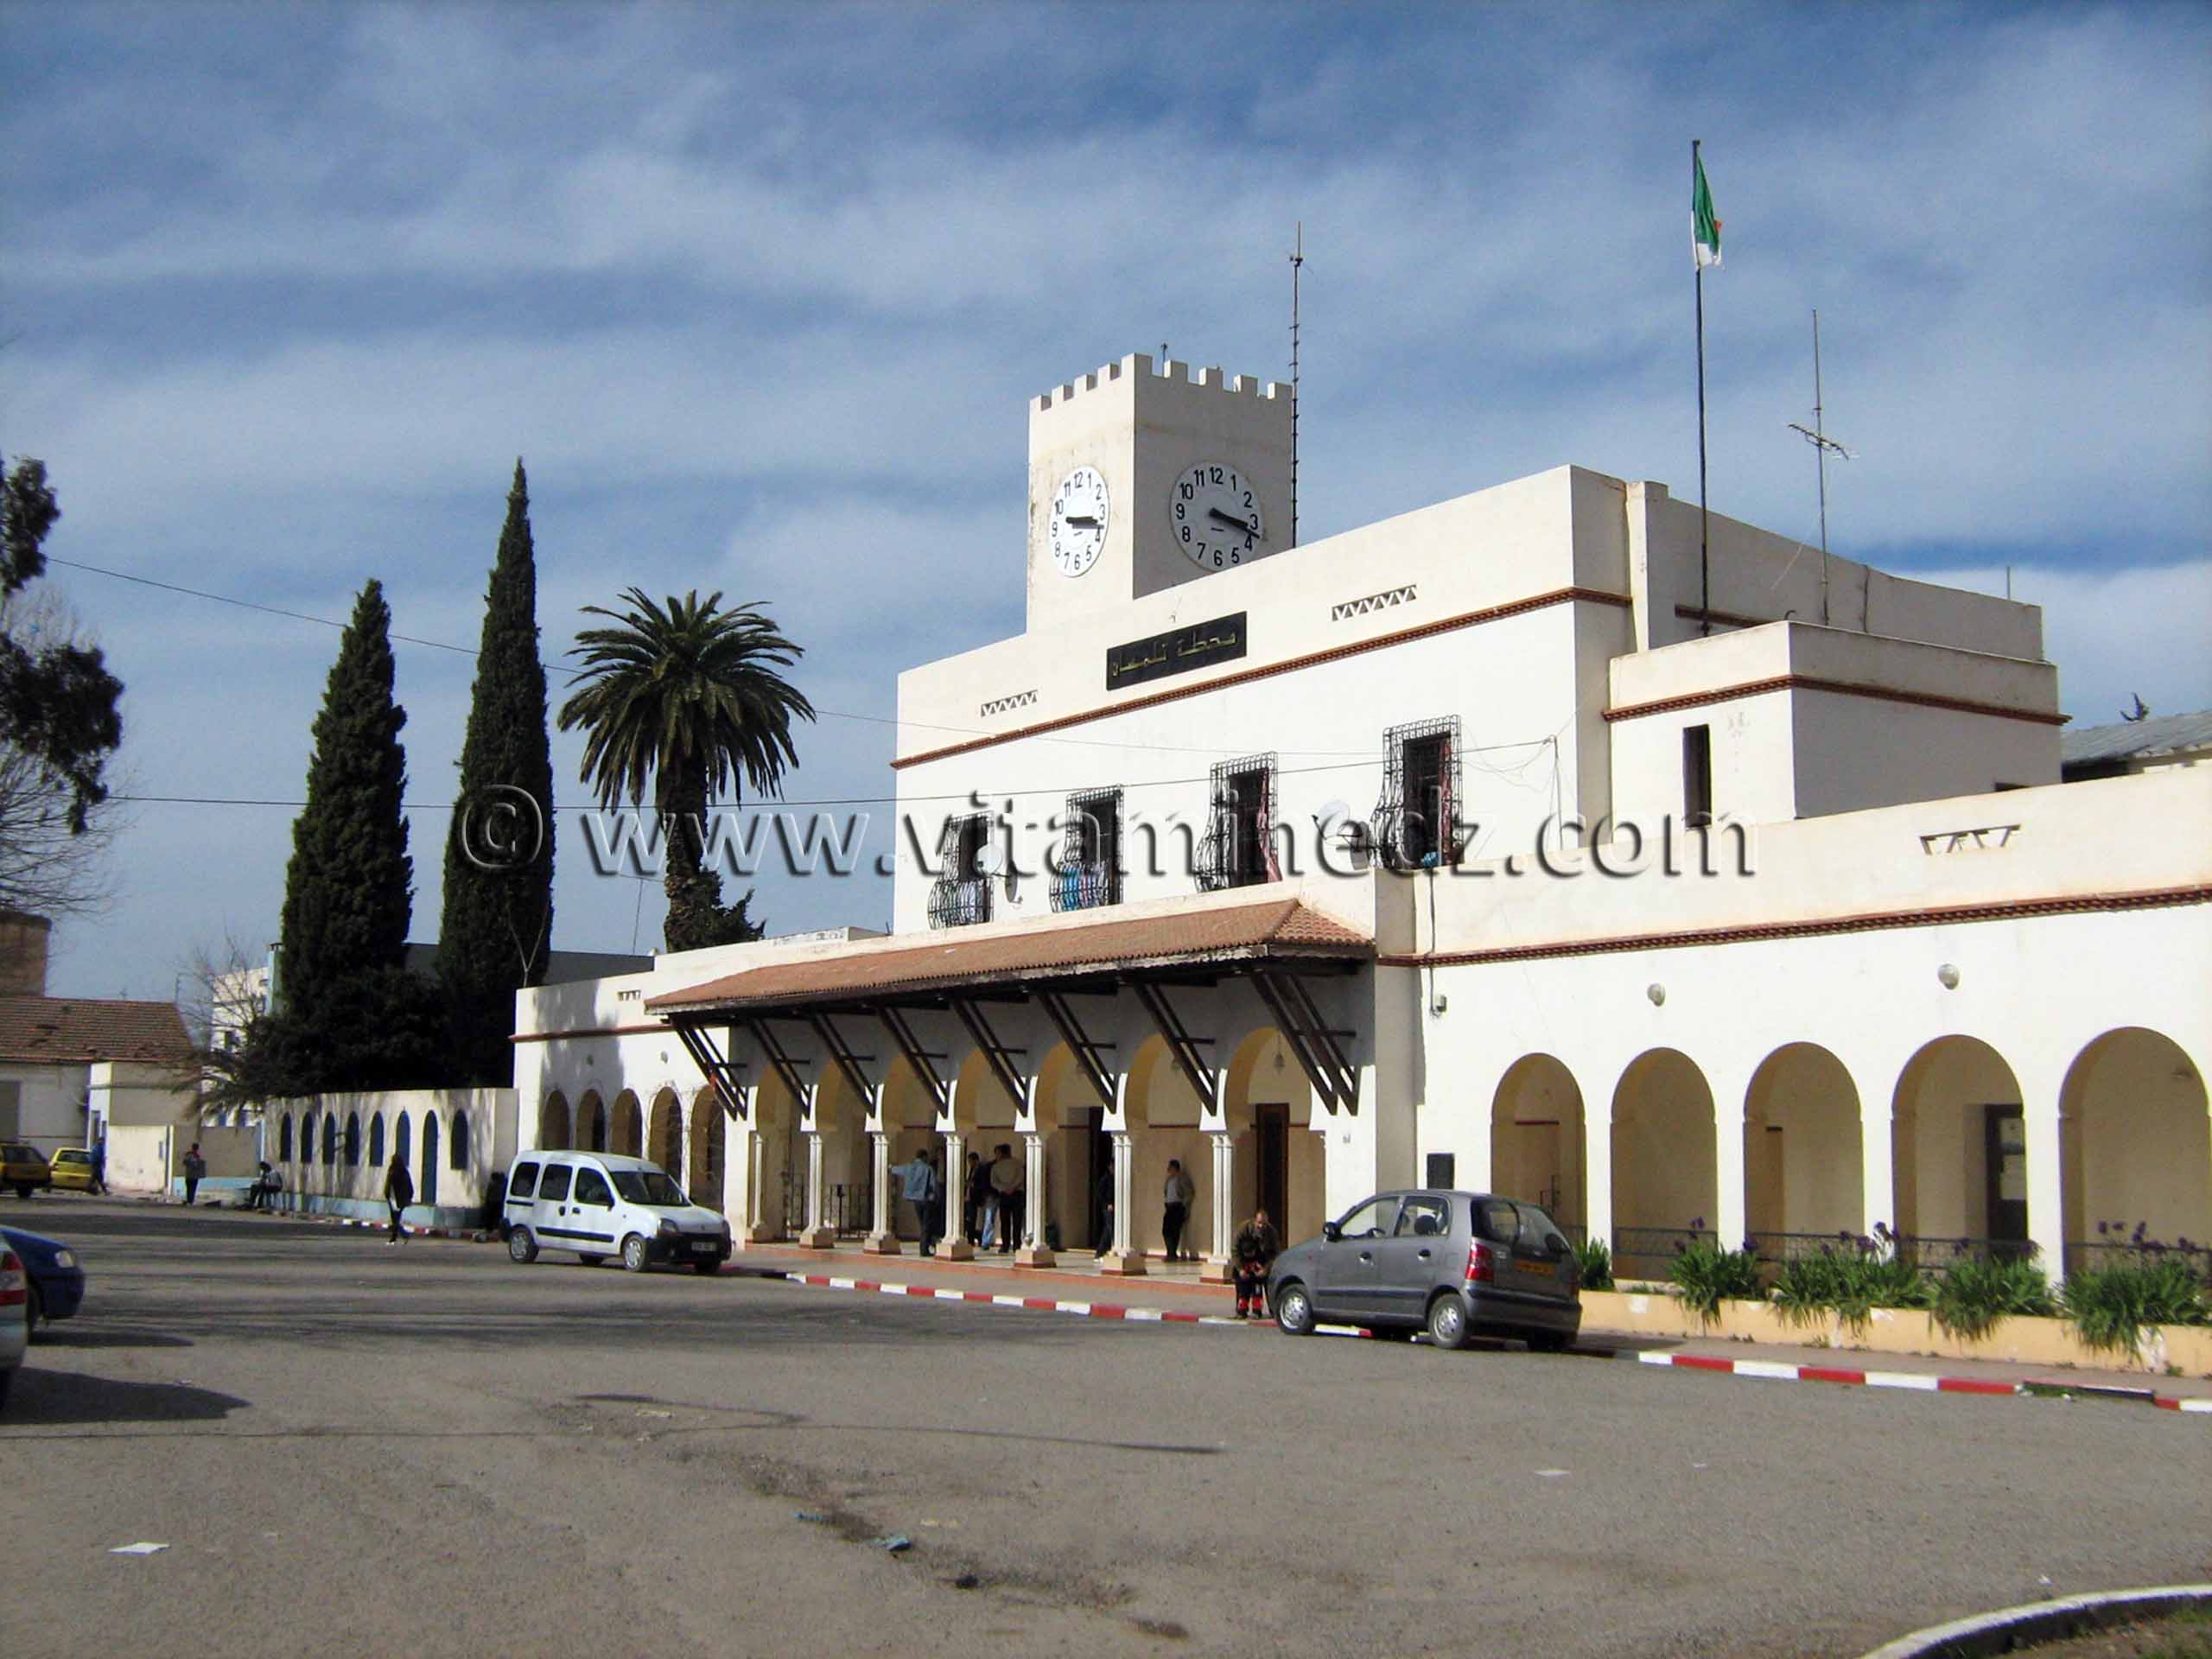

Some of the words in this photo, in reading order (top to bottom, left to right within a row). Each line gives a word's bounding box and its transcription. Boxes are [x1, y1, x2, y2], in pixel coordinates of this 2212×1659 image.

[1074, 471, 1084, 489] 12
[1193, 469, 1205, 487] 11
[1209, 467, 1224, 485] 12
[1230, 474, 1236, 492] 1
[1064, 480, 1071, 499] 11
[1096, 483, 1103, 501] 2
[1179, 482, 1194, 500] 10
[1054, 499, 1064, 517] 10
[1243, 491, 1253, 508] 2
[1099, 504, 1105, 521] 3
[1175, 503, 1185, 520] 9
[1052, 521, 1058, 538] 9
[1249, 513, 1258, 531] 3
[1181, 525, 1191, 543] 8
[1244, 533, 1253, 551] 4
[1054, 541, 1061, 558] 8
[1085, 544, 1092, 562] 5
[1197, 542, 1206, 560] 7
[1213, 550, 1223, 567] 6
[1231, 547, 1240, 564] 5
[1064, 551, 1071, 570] 7
[1074, 553, 1081, 571] 6
